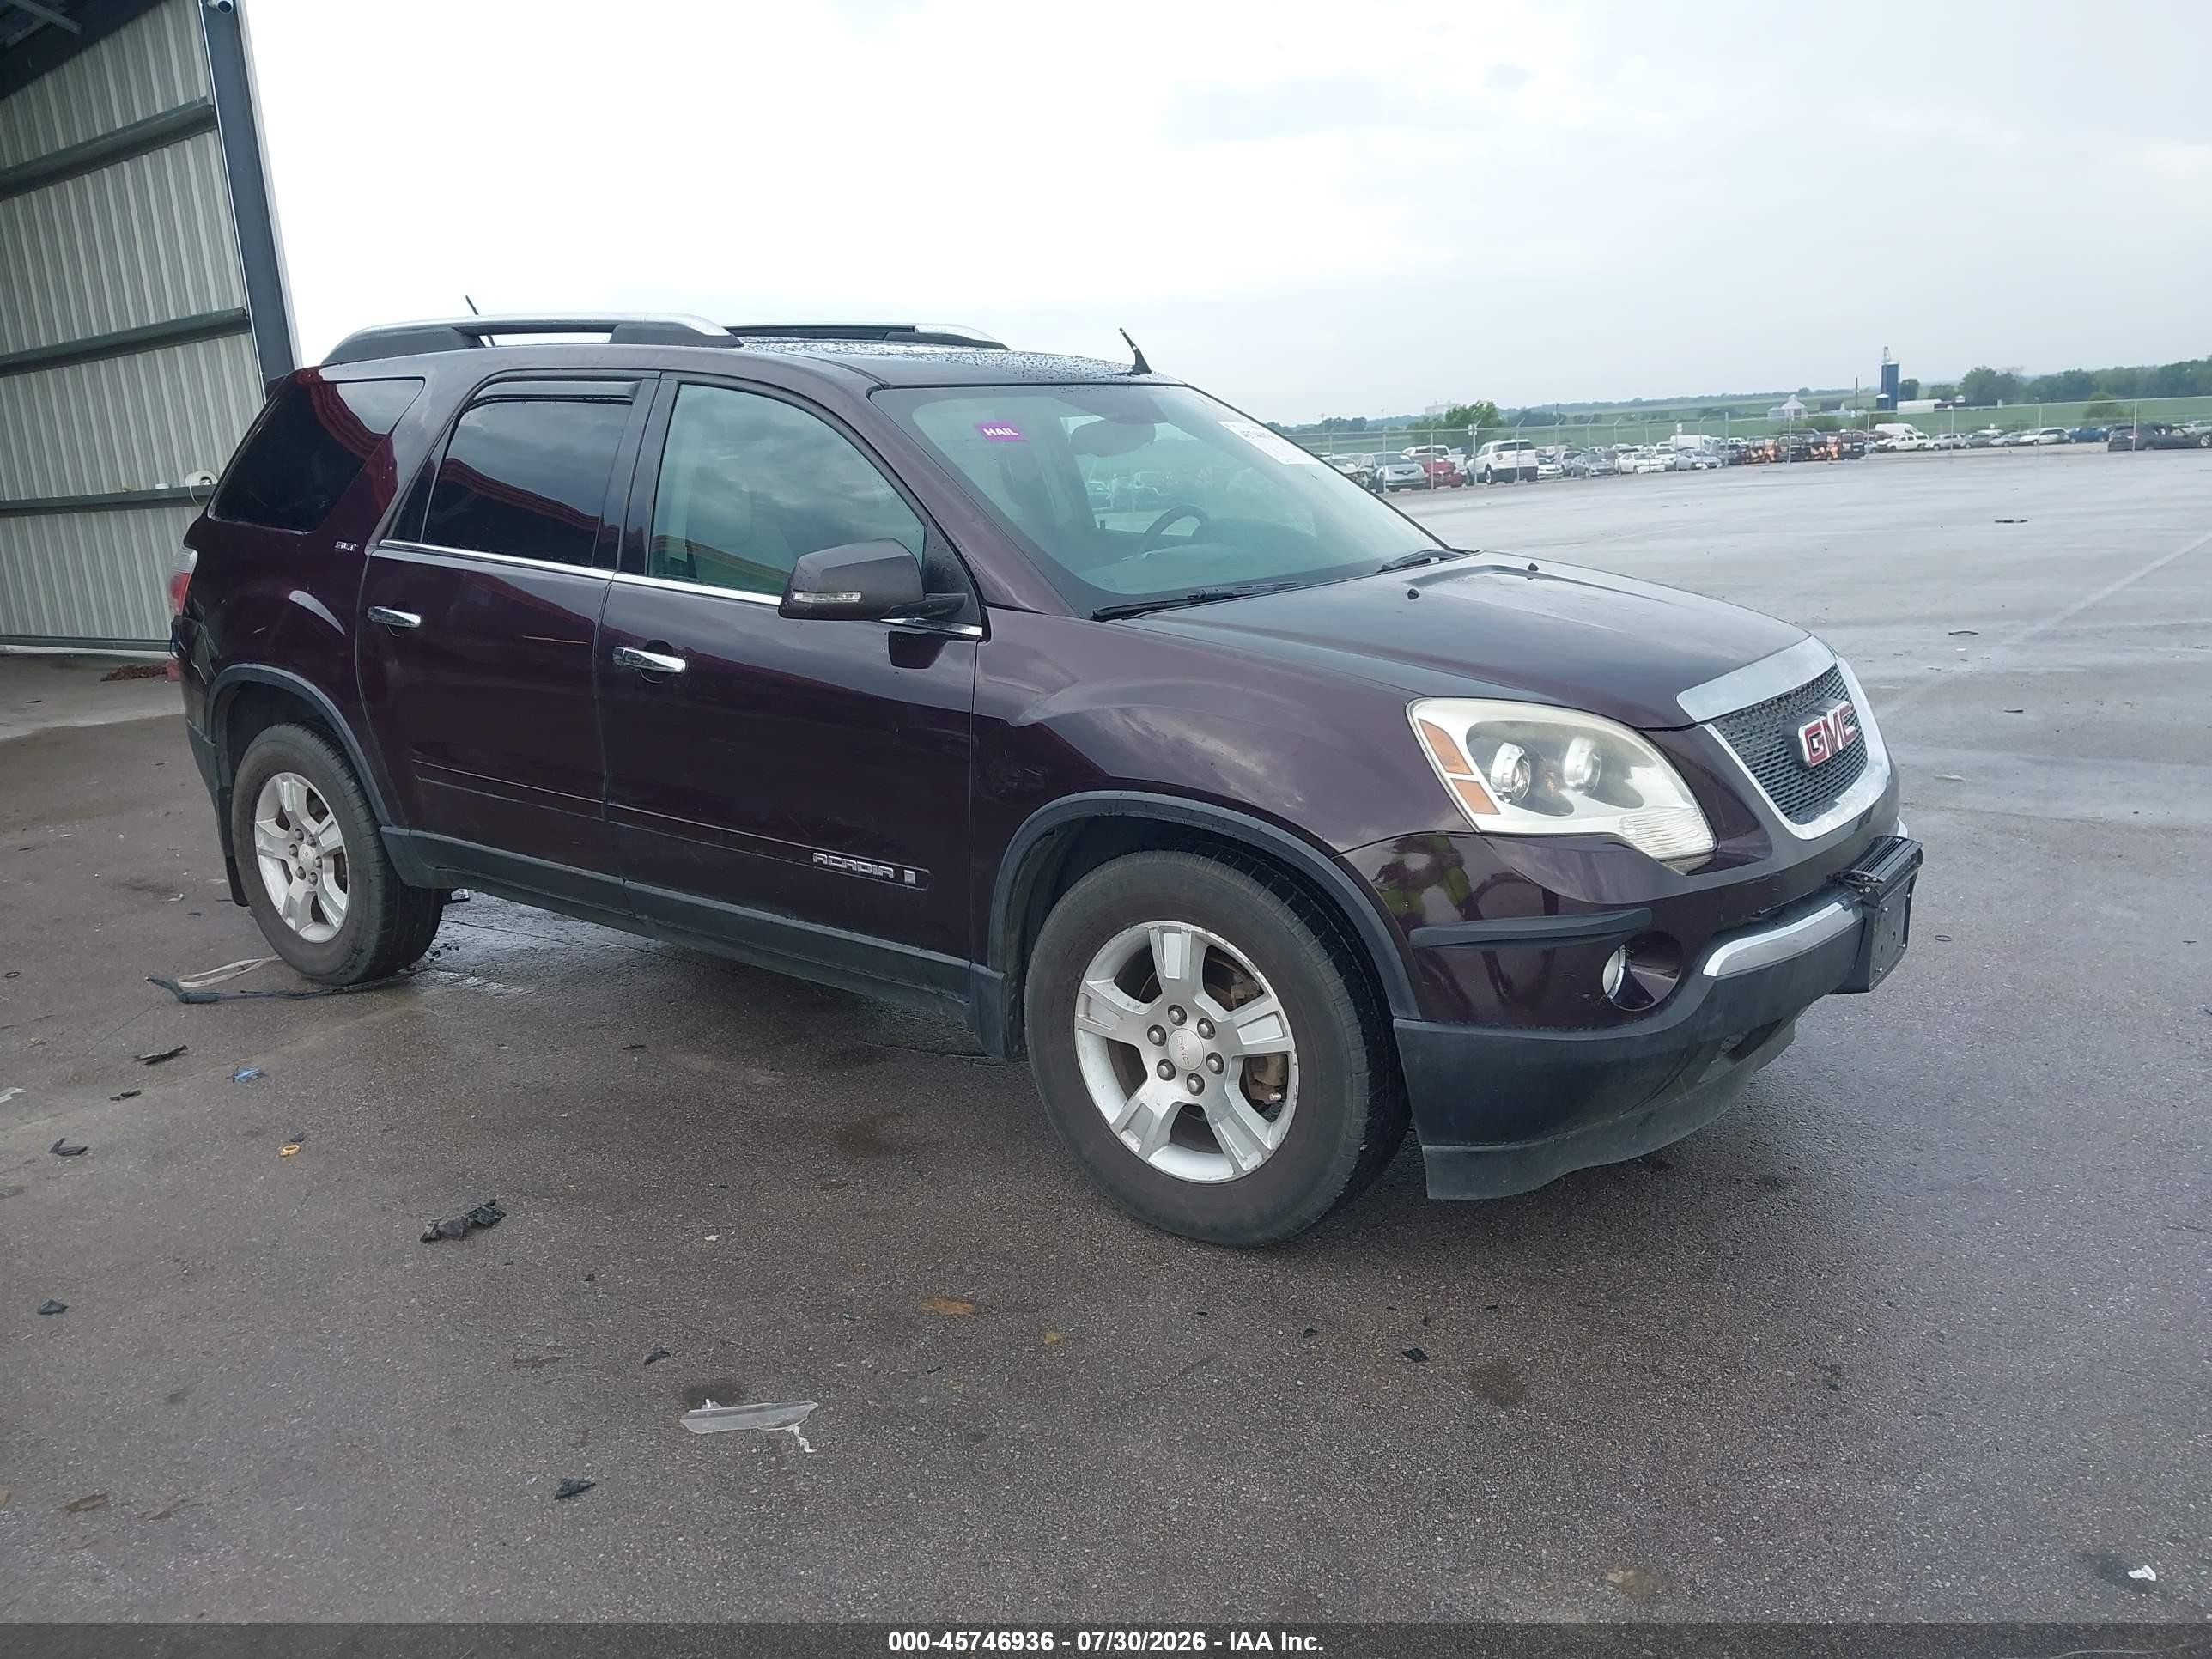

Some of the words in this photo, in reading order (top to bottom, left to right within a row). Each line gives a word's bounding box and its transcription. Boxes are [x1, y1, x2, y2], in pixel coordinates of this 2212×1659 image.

[982, 427, 1019, 436] HAIL
[1798, 701, 1856, 768] GMC
[812, 852, 895, 879] ACADIA
